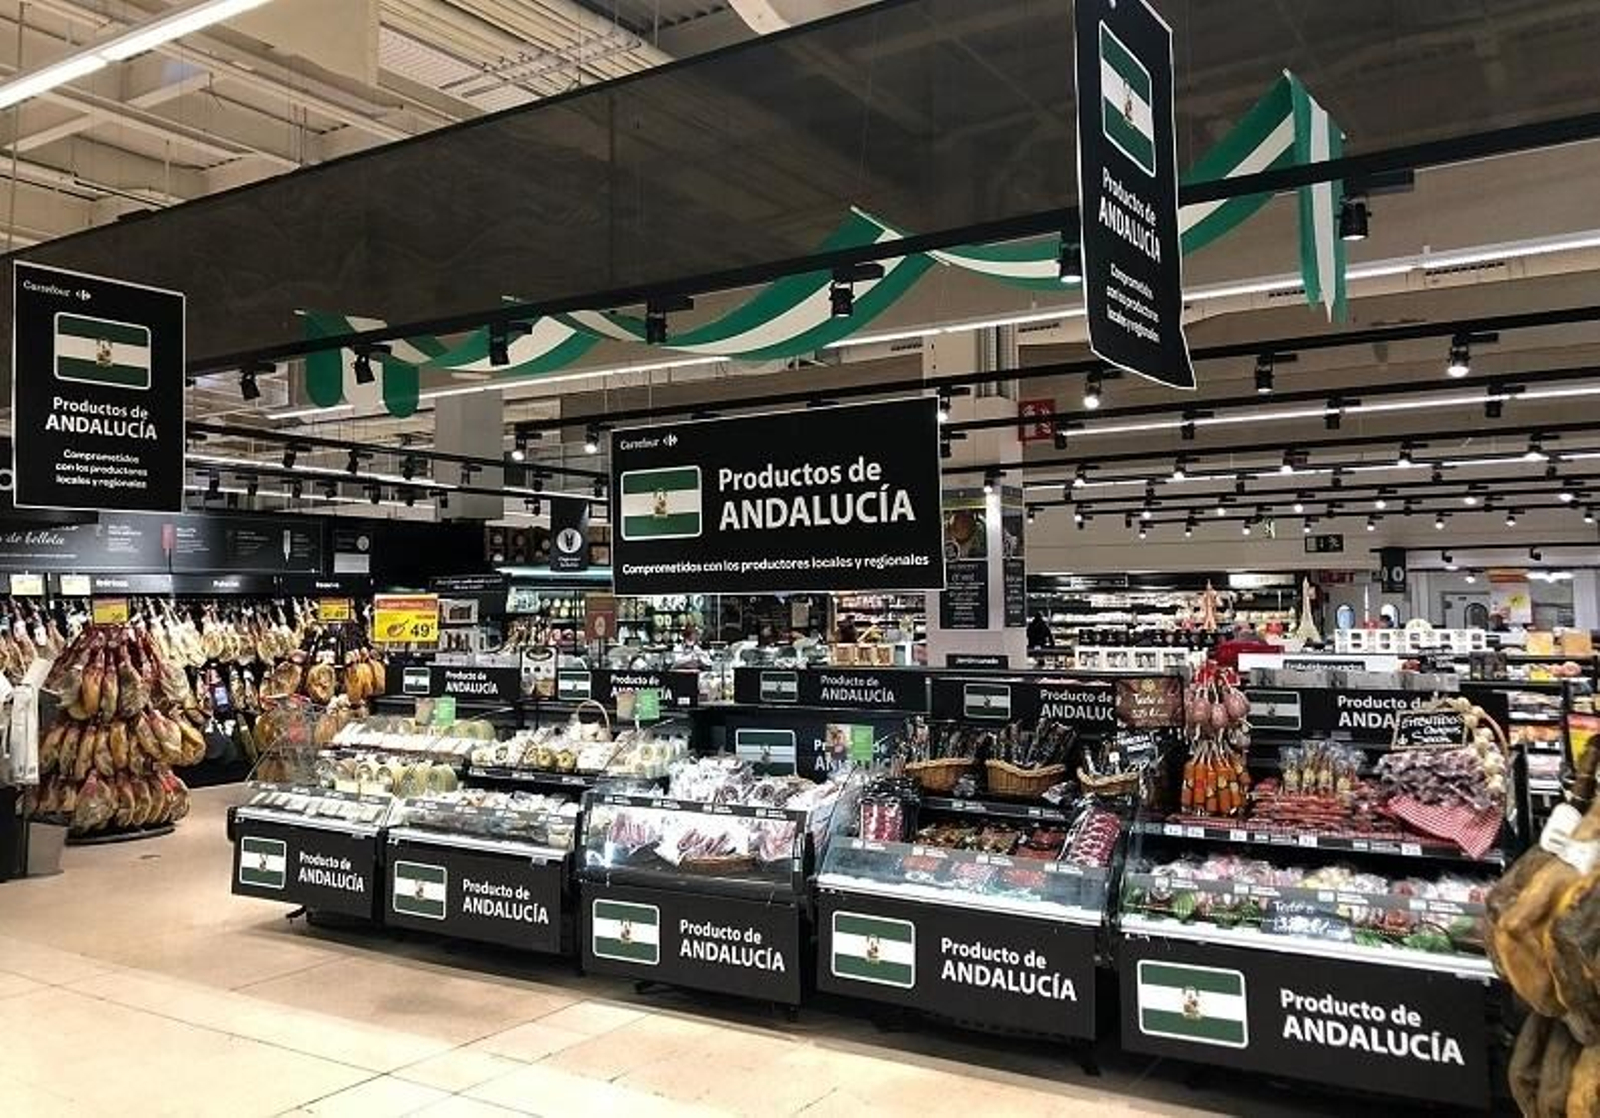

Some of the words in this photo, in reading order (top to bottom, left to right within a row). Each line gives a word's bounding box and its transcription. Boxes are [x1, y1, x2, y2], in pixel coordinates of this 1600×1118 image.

[1102, 166, 1144, 218] Productos
[1145, 203, 1156, 227] de
[1099, 196, 1161, 263] ANDALUCÍA
[53, 396, 127, 418] Productos
[130, 405, 148, 420] de
[45, 413, 158, 440] ANDALUCÍA
[63, 448, 140, 464] Comprometidos
[55, 462, 75, 471] con
[76, 462, 89, 473] los
[90, 465, 148, 477] productores
[718, 463, 842, 492] Productos
[848, 455, 883, 483] de
[55, 474, 91, 485] locales
[92, 479, 97, 487] y
[98, 478, 148, 489] regionales
[718, 484, 917, 531] ANDALUCÍA
[622, 560, 702, 576] Comprometidos
[703, 562, 723, 572] con
[723, 559, 740, 571] los
[741, 557, 811, 573] productores
[812, 556, 854, 568] locales
[854, 557, 862, 570] y
[864, 553, 930, 570] regionales
[445, 670, 476, 680] Producto
[477, 671, 487, 681] de
[610, 674, 648, 686] Producto
[649, 675, 660, 687] de
[820, 675, 865, 687] Producto
[866, 677, 881, 688] de
[444, 681, 499, 695] ANDALUCÍA
[820, 687, 896, 703] ANDALUCÍA
[1040, 688, 1096, 703] Producto
[1096, 691, 1114, 704] de
[1040, 703, 1114, 721] ANDALUC
[1338, 694, 1408, 709] Producto
[1410, 697, 1421, 709] d
[299, 850, 340, 869] Producto
[340, 857, 352, 872] de
[297, 866, 365, 893] ANDALUCÍA
[462, 878, 514, 900] Producto
[515, 882, 531, 900] de
[462, 897, 550, 925] ANDALUCÍA
[679, 919, 742, 942] Producto
[743, 927, 763, 945] de
[679, 938, 786, 973] ANDALUCÍA
[940, 937, 1020, 966] Producto
[1023, 949, 1048, 970] de
[940, 959, 1078, 1002] ANDALUCÍA
[1279, 988, 1387, 1026] Producto
[1389, 1003, 1422, 1028] de
[1282, 1015, 1466, 1067] ANDALUCÍA
